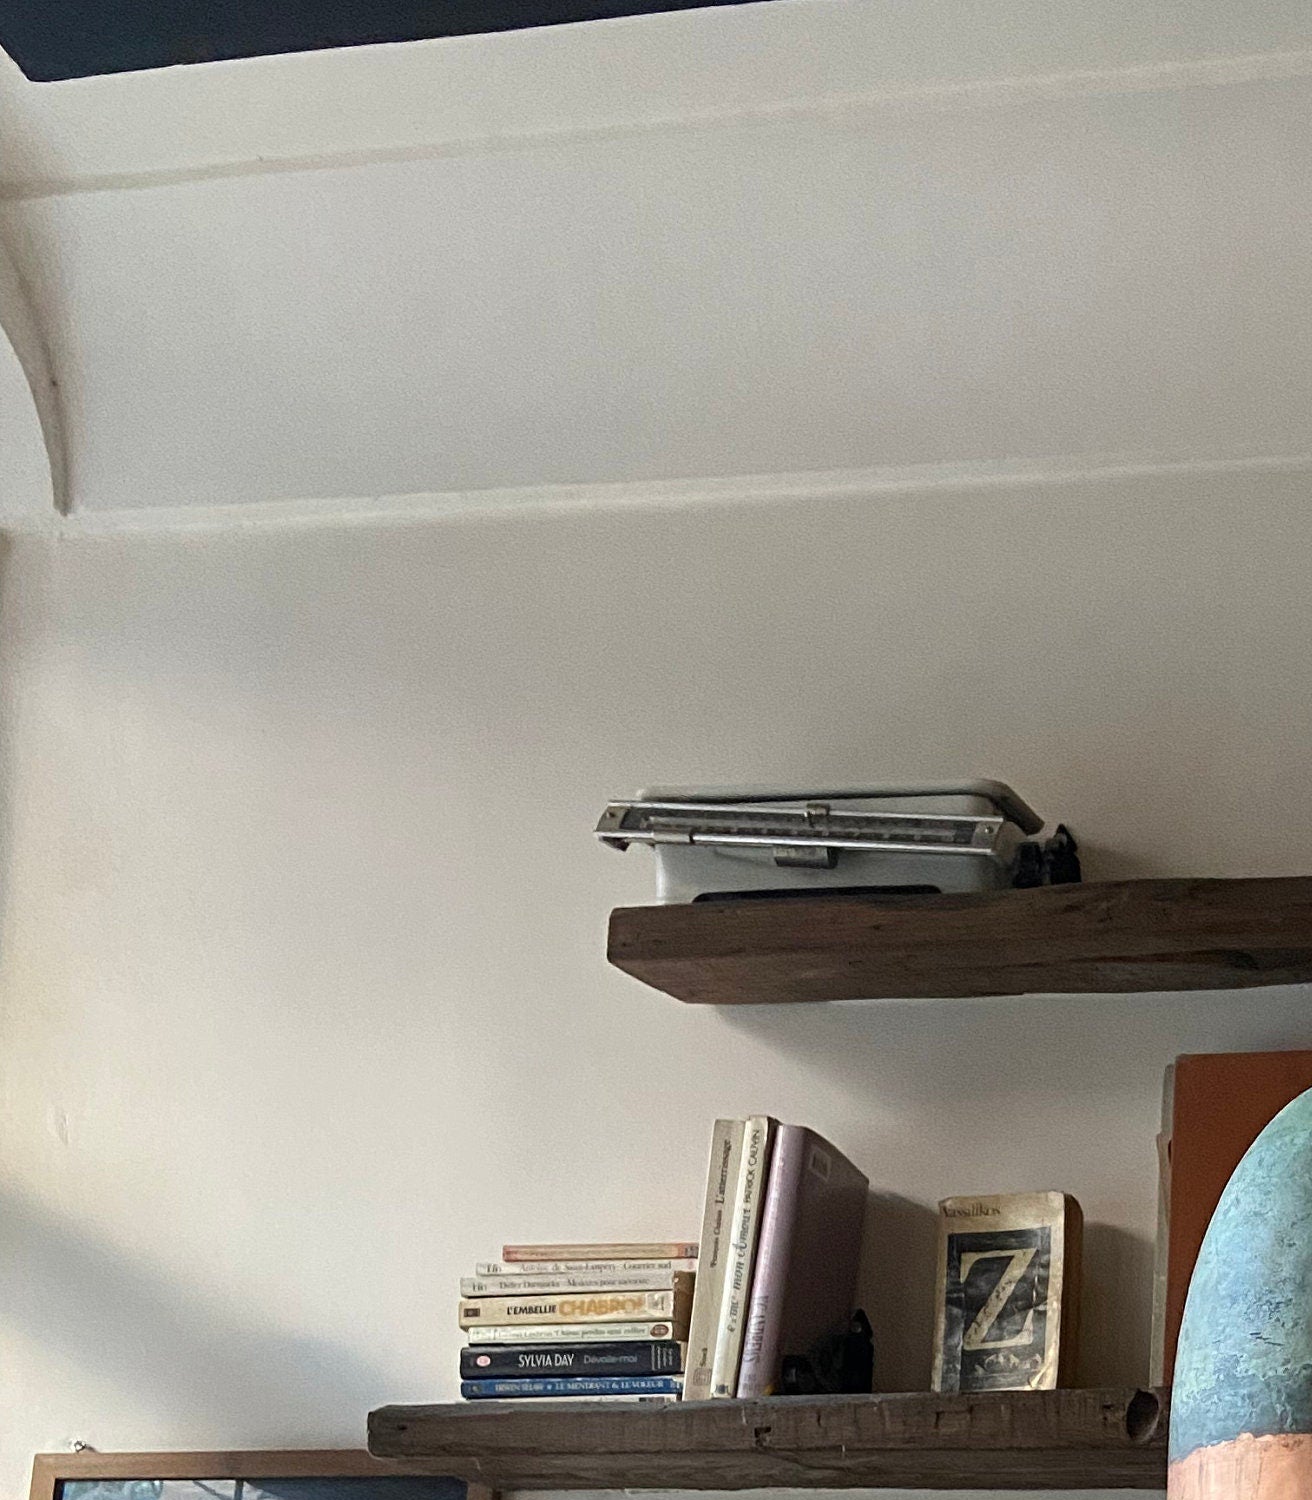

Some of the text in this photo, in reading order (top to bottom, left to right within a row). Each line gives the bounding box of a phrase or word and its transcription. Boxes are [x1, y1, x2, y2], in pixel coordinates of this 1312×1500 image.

[749, 1128, 761, 1167] CAUVIN
[744, 1166, 757, 1205] PATRICK
[506, 1304, 557, 1315] L'EMBELLIE
[960, 1247, 1039, 1351] Z
[518, 1353, 552, 1368] SYLVIA
[554, 1353, 574, 1367] DAY
